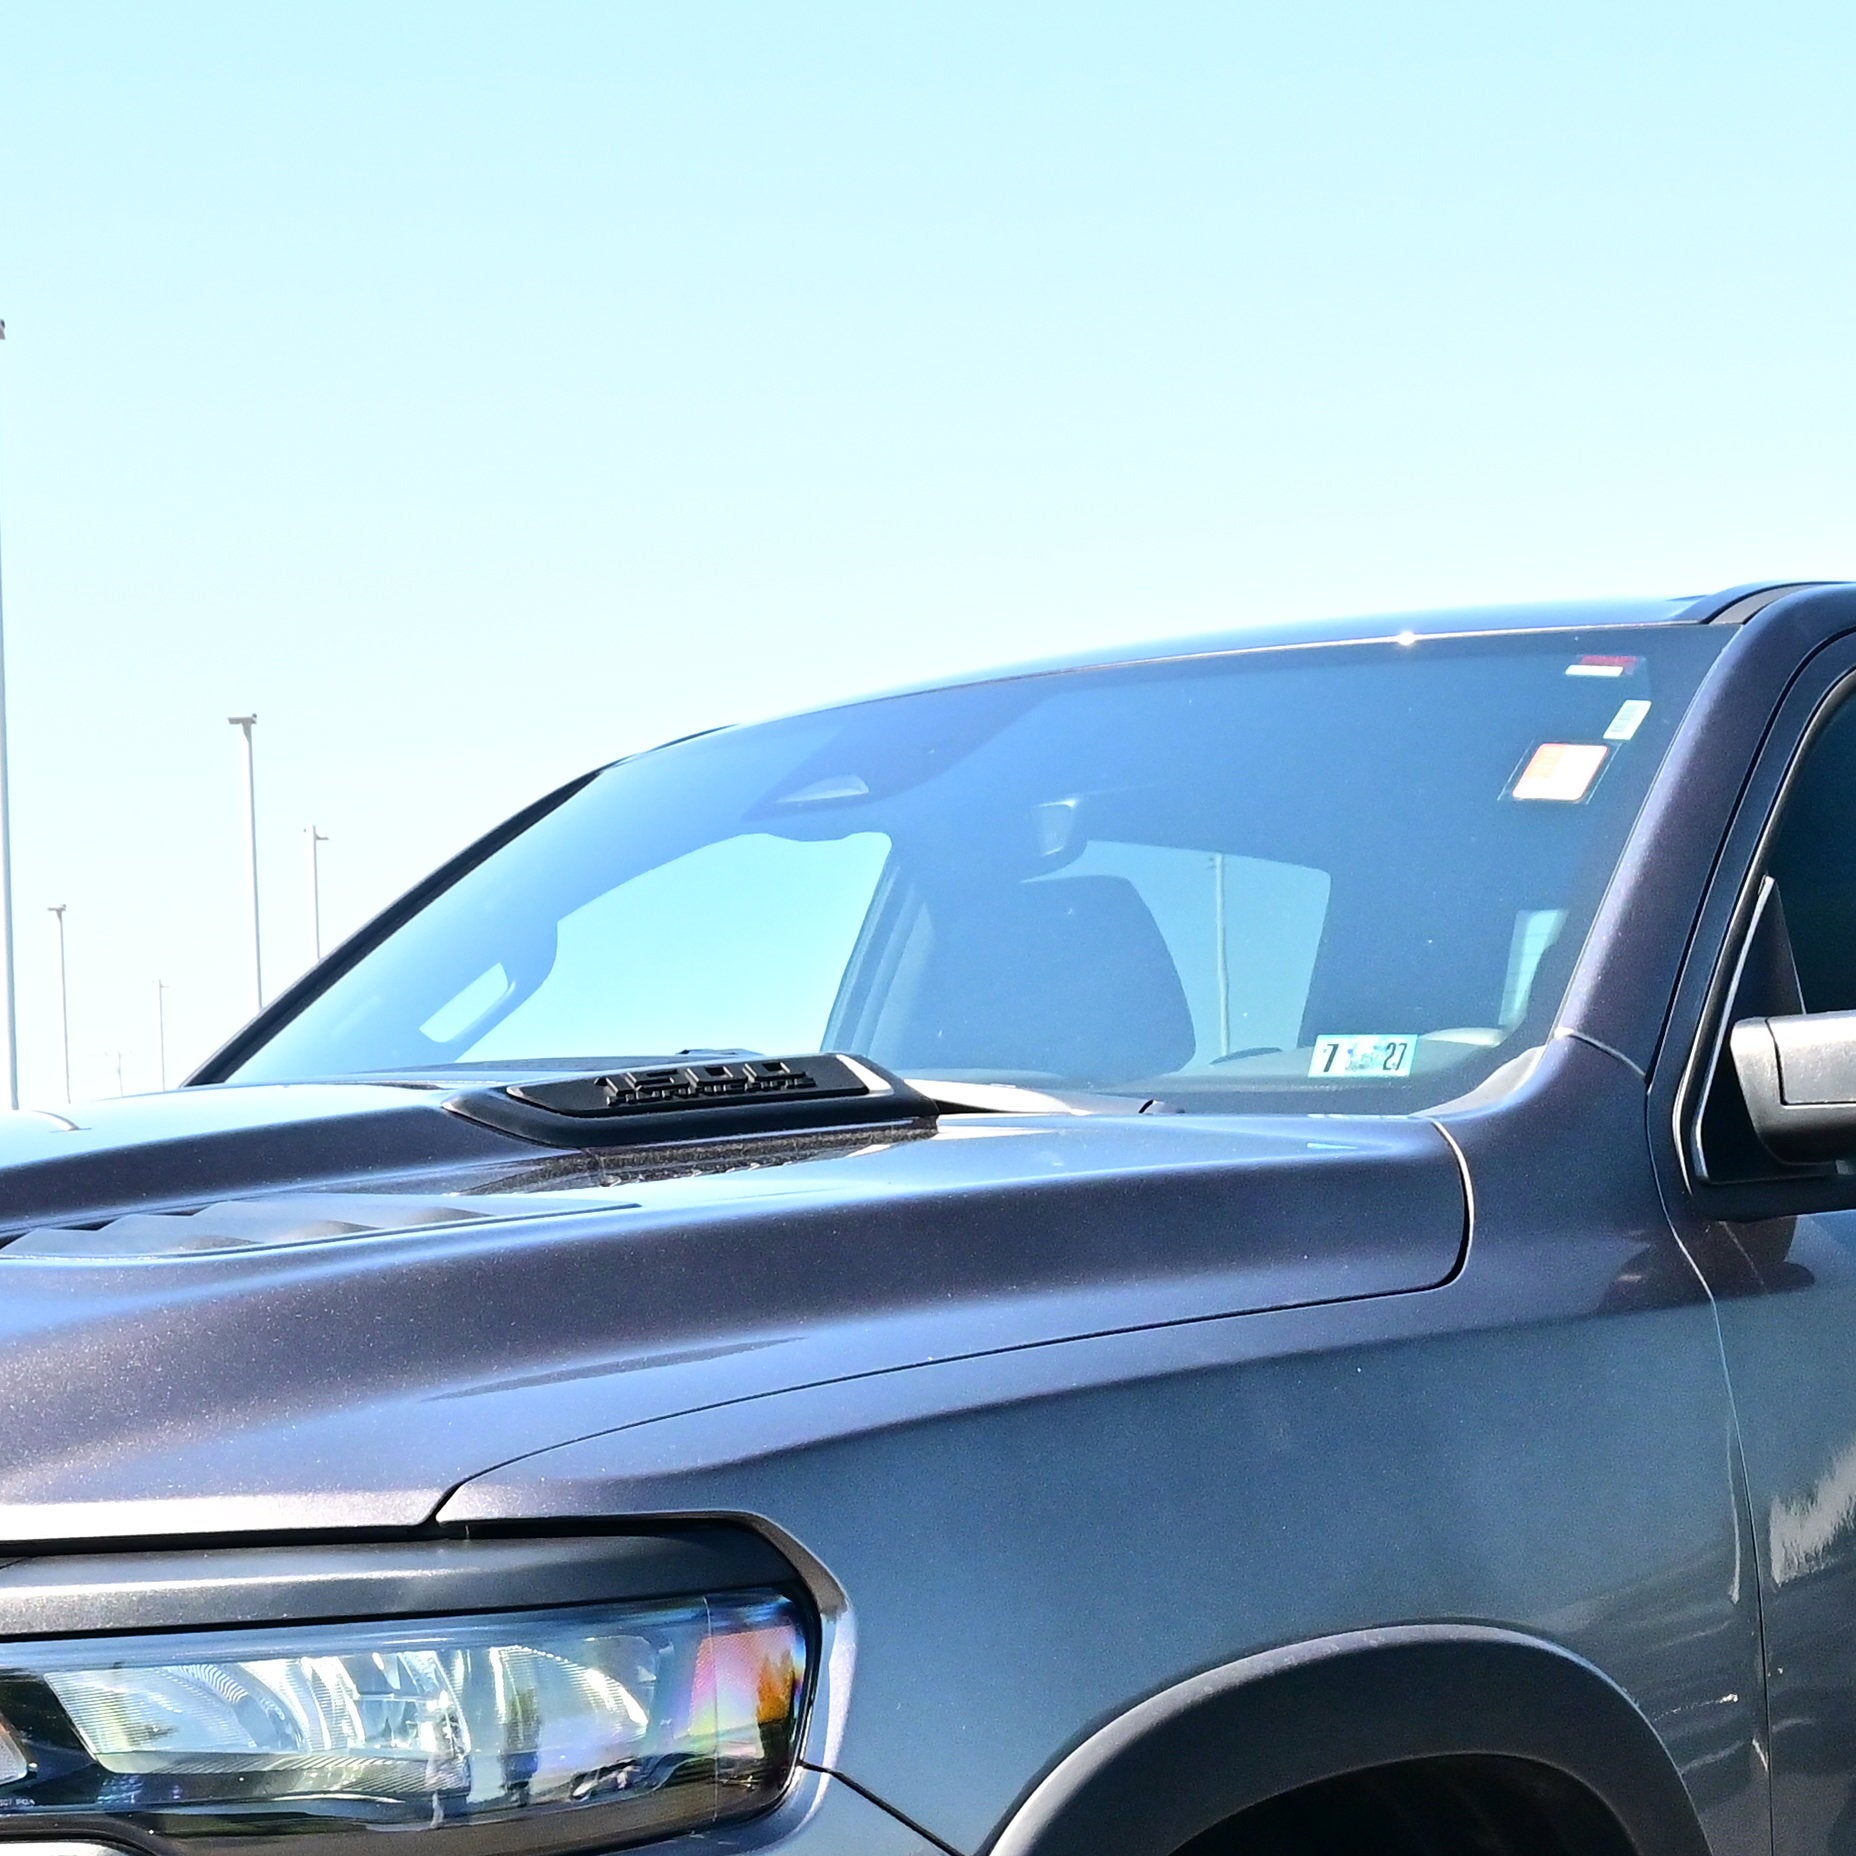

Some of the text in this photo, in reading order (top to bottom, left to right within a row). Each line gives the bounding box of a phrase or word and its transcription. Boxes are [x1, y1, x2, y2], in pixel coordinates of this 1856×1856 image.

[1323, 1042, 1408, 1073] 7 27
[594, 1061, 806, 1096] 1500
